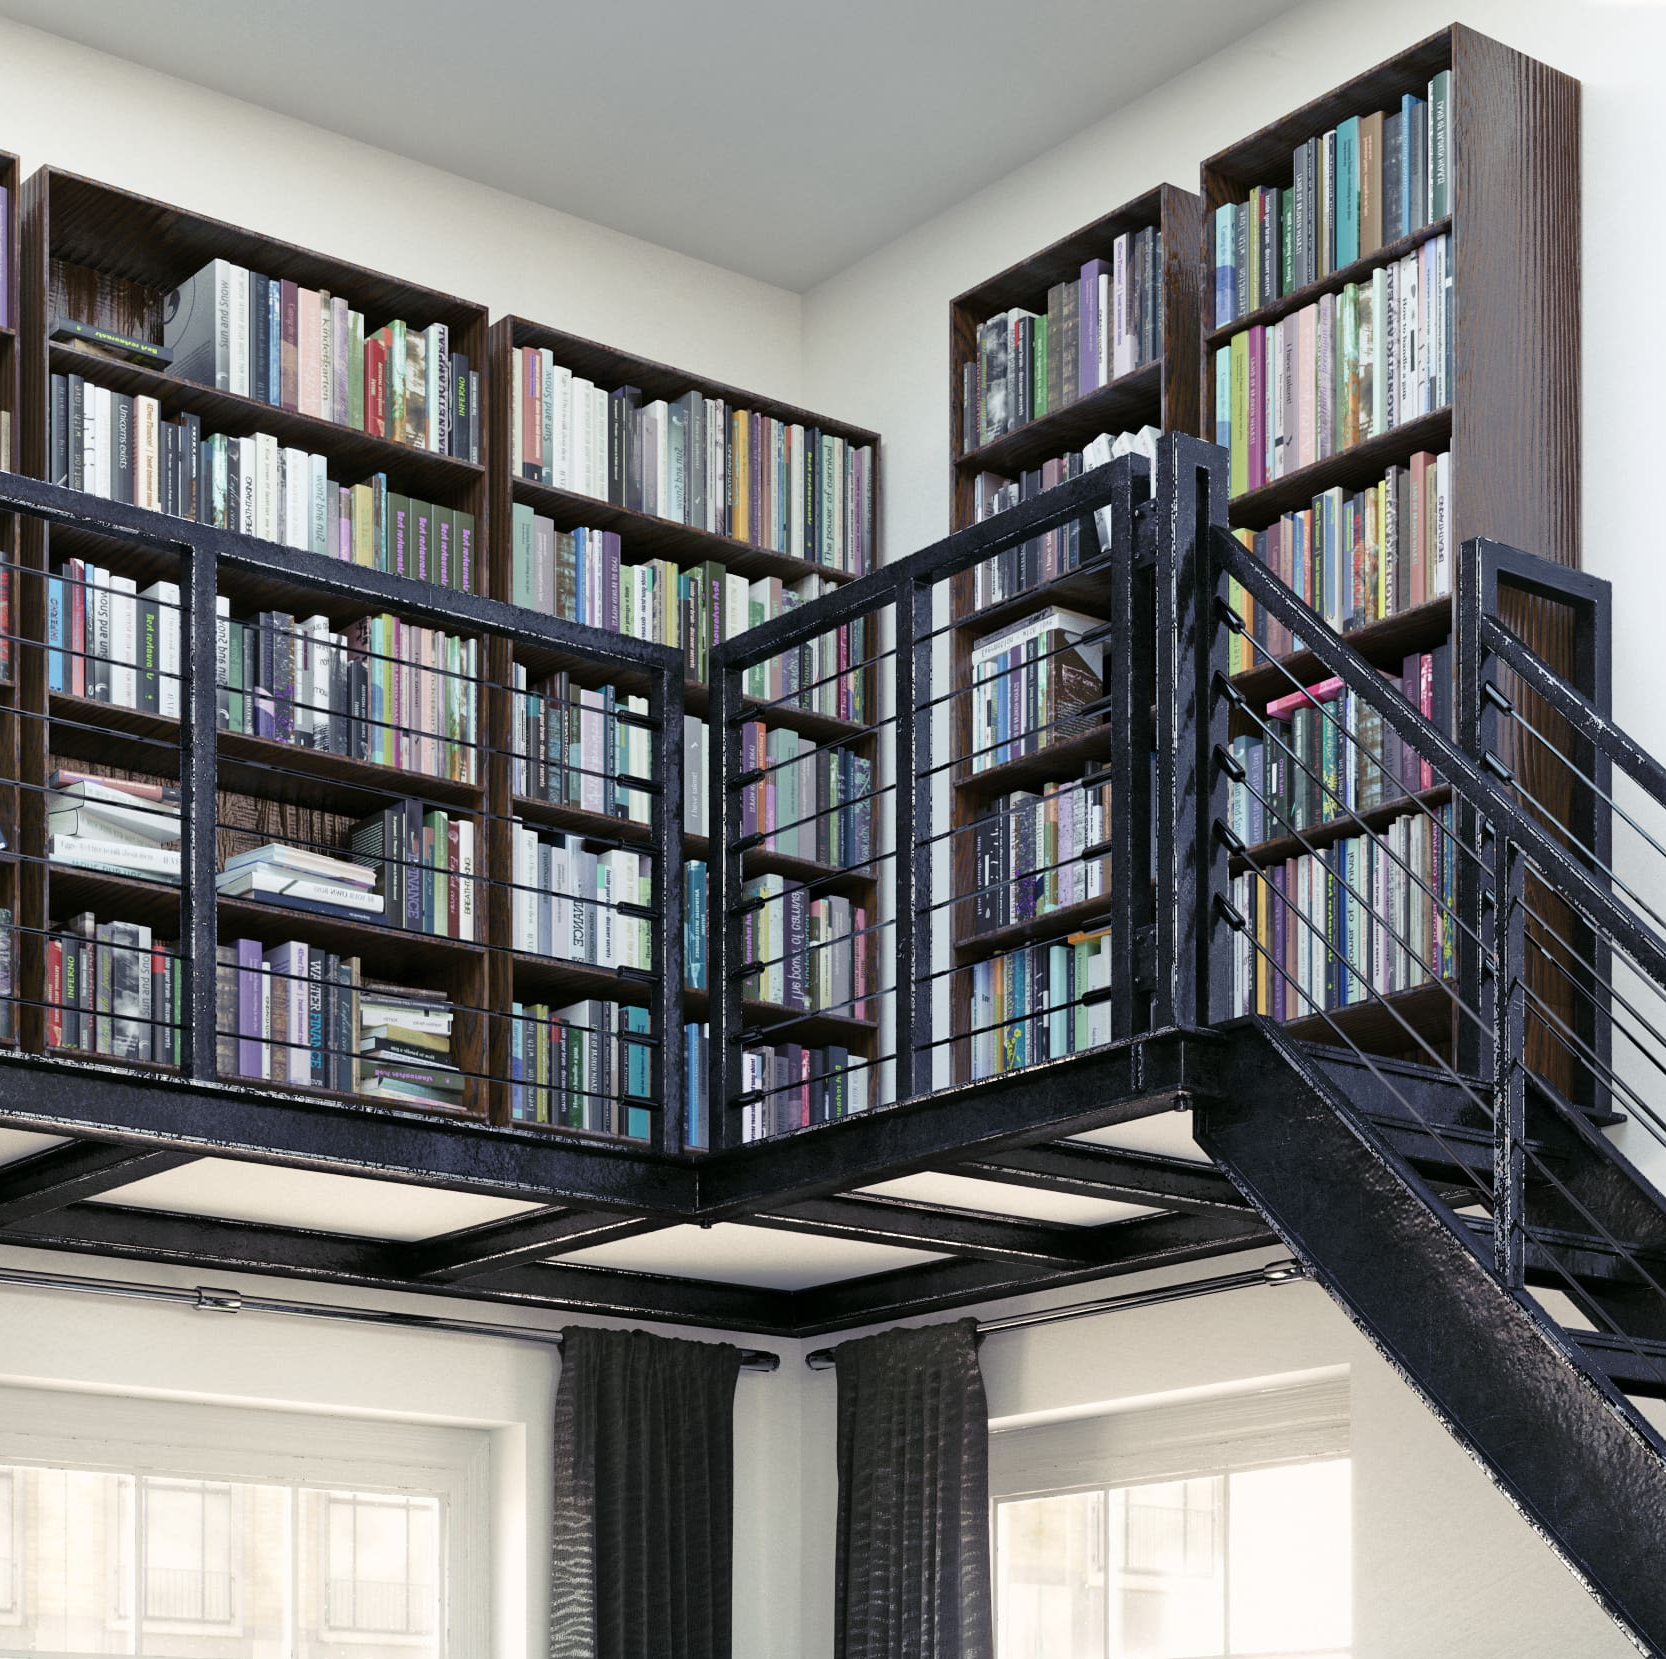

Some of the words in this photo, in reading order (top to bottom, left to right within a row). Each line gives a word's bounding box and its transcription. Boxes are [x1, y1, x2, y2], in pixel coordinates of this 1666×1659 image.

[219, 279, 230, 305] Snow
[219, 307, 231, 326] and
[219, 327, 230, 348] Sun
[321, 317, 332, 401] Kindergarten
[457, 376, 466, 417] INFERNO
[543, 370, 553, 399] Snow
[118, 404, 129, 443] Unicorns
[543, 401, 554, 421] and
[543, 423, 553, 443] Sun
[118, 444, 129, 469] exists
[396, 510, 405, 528] Best
[418, 516, 427, 534] Best
[440, 523, 449, 540] Best
[462, 528, 471, 546] Best
[396, 529, 405, 574] restaurants
[418, 535, 427, 580] restaurants
[440, 541, 449, 586] restaurants
[825, 542, 835, 563] The
[462, 547, 471, 592] restaurants
[97, 619, 108, 639] and
[145, 613, 155, 631] Best
[145, 632, 155, 681] restaurats
[67, 955, 75, 999] INFERNO
